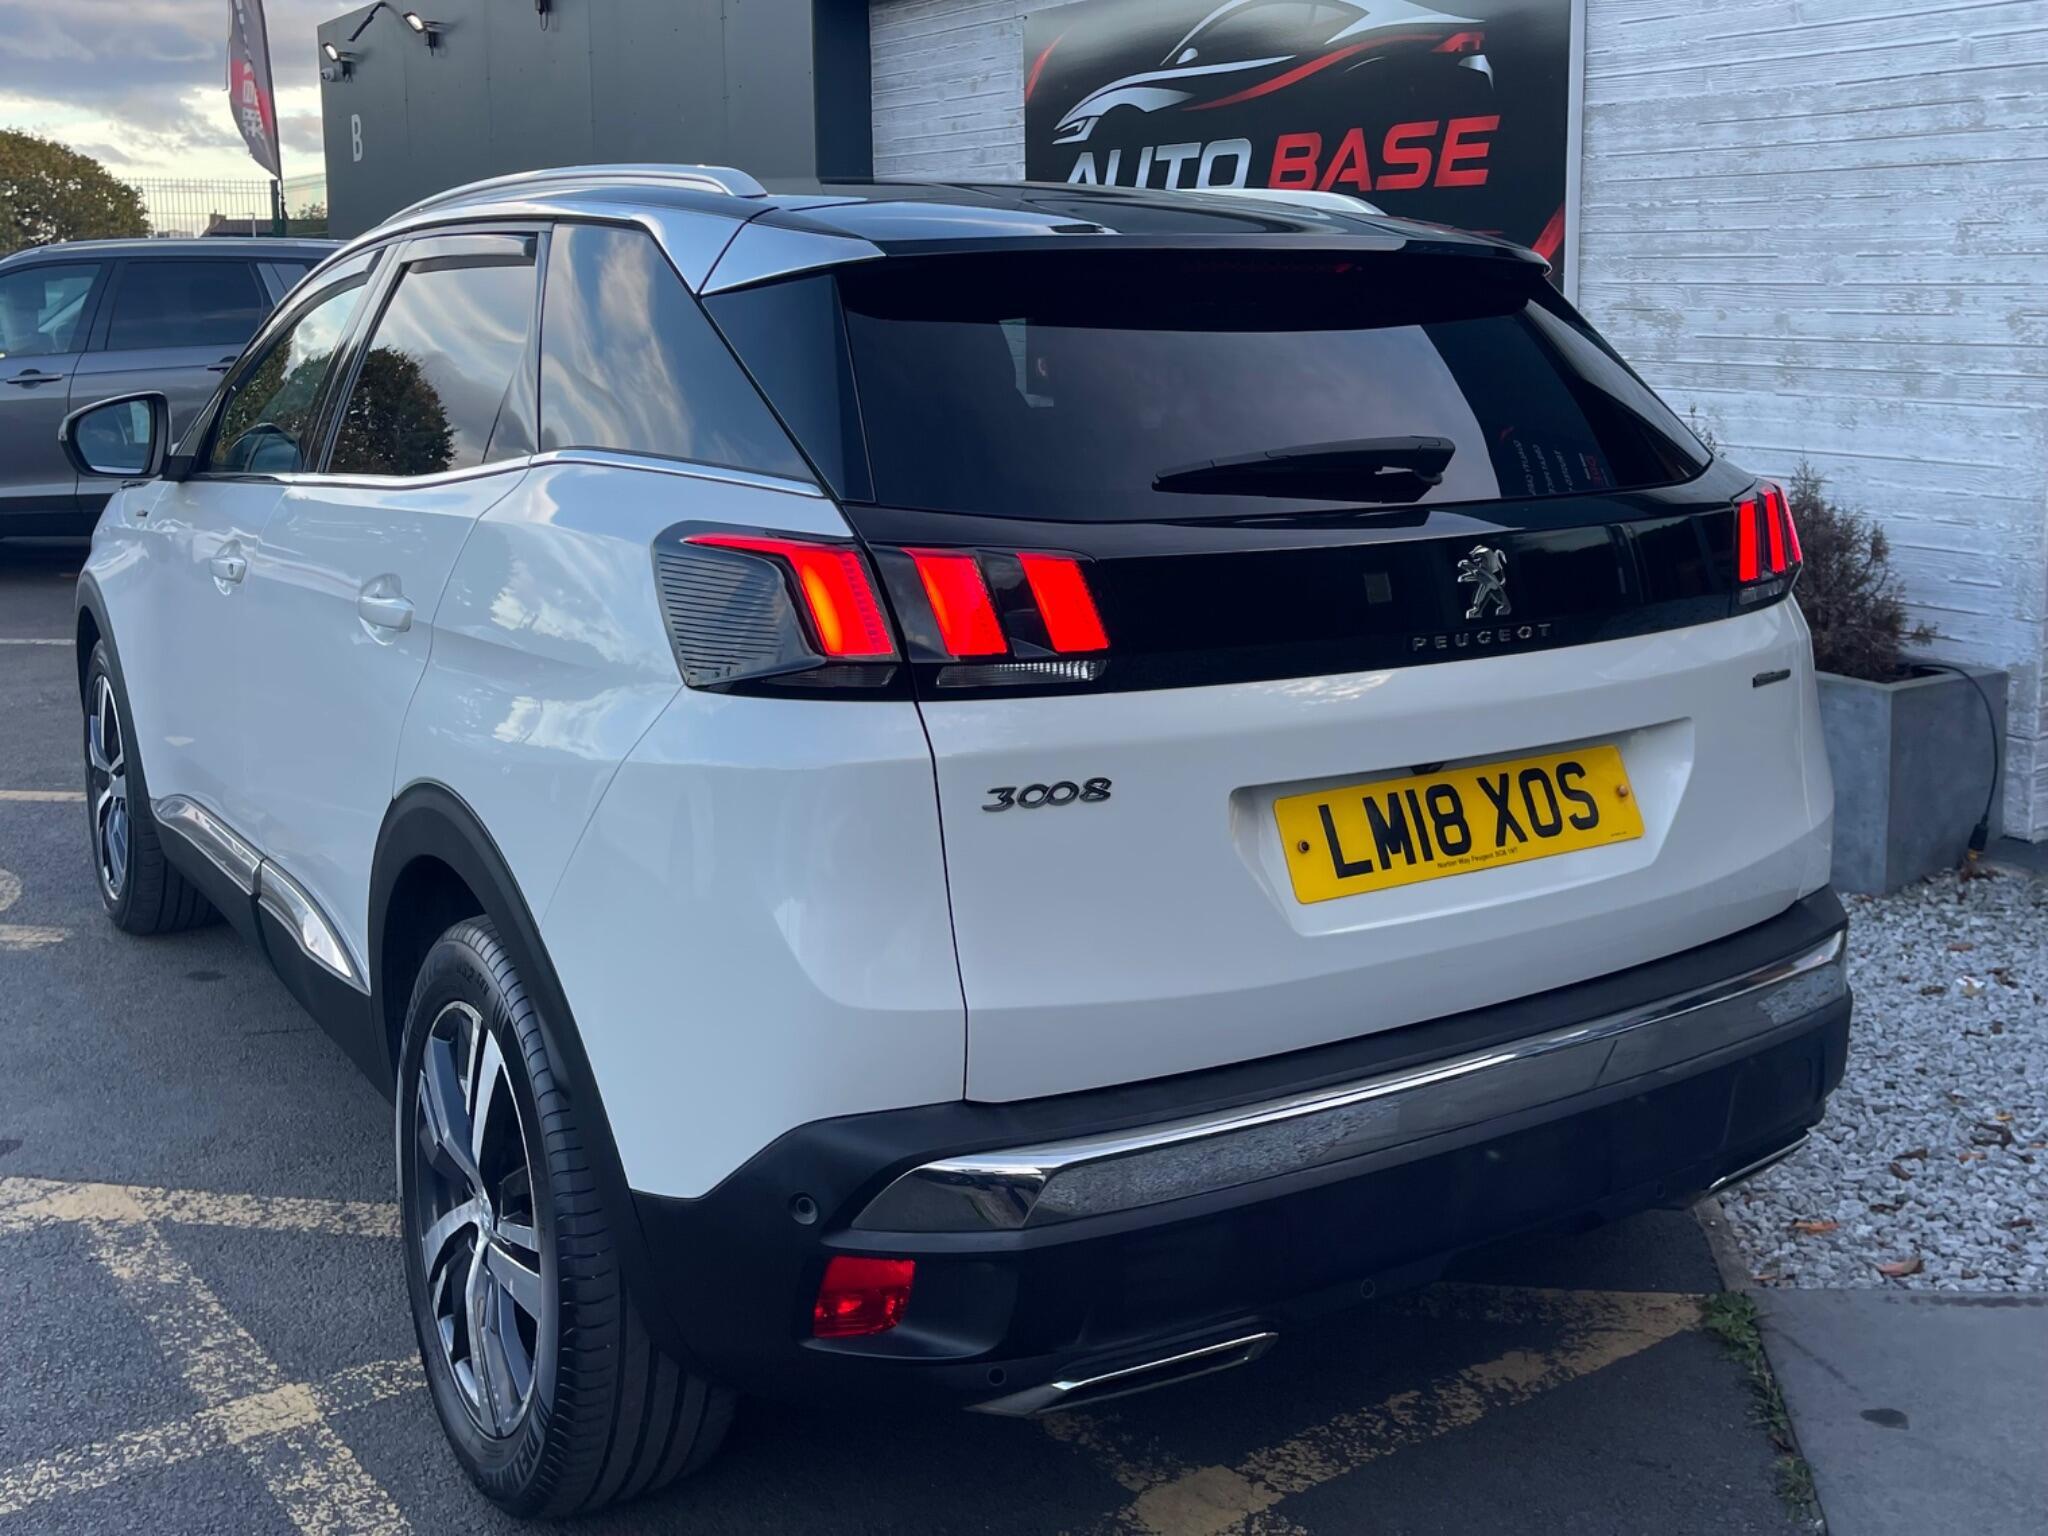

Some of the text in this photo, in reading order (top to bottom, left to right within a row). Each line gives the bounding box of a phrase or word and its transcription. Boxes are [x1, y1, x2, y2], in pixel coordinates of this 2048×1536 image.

[351, 114, 363, 162] B
[1066, 115, 1500, 191] AUTO BASE
[1412, 623, 1552, 651] PEUGEOT
[982, 777, 1112, 812] 3008
[1318, 761, 1599, 879] LM18 XOS
